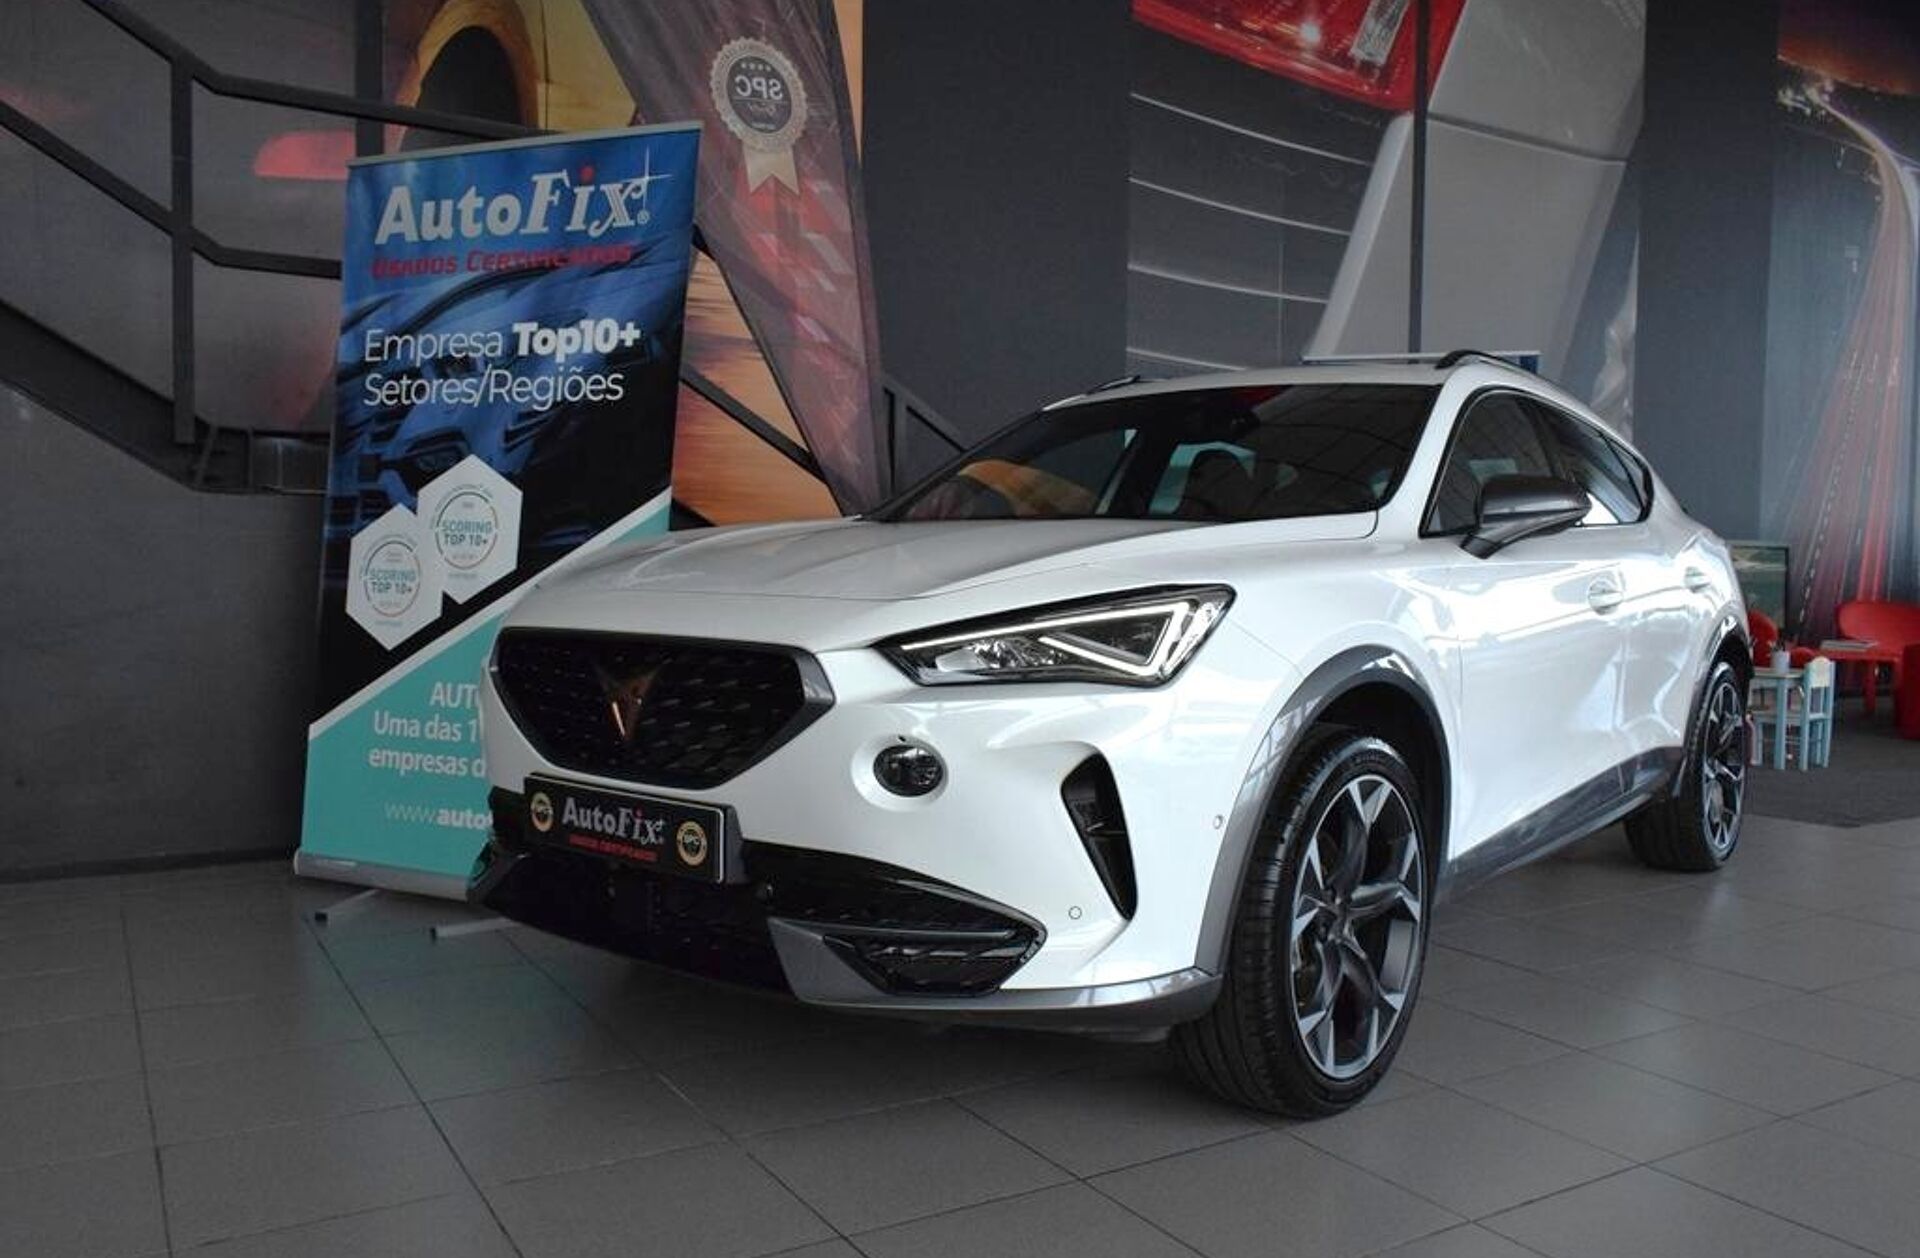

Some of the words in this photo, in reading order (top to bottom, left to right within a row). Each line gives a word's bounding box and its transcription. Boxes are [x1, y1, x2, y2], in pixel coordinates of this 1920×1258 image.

[365, 328, 502, 367] Empresa
[512, 318, 641, 362] Top10+
[363, 365, 625, 412] Setores/Regiões
[442, 520, 492, 534] SCORING
[444, 533, 465, 547] TOP
[369, 568, 417, 582] SCORING
[371, 581, 392, 595] TOP
[430, 681, 480, 709] AUT
[373, 709, 421, 738] Uma
[424, 713, 462, 742] das
[369, 748, 468, 776] empresas
